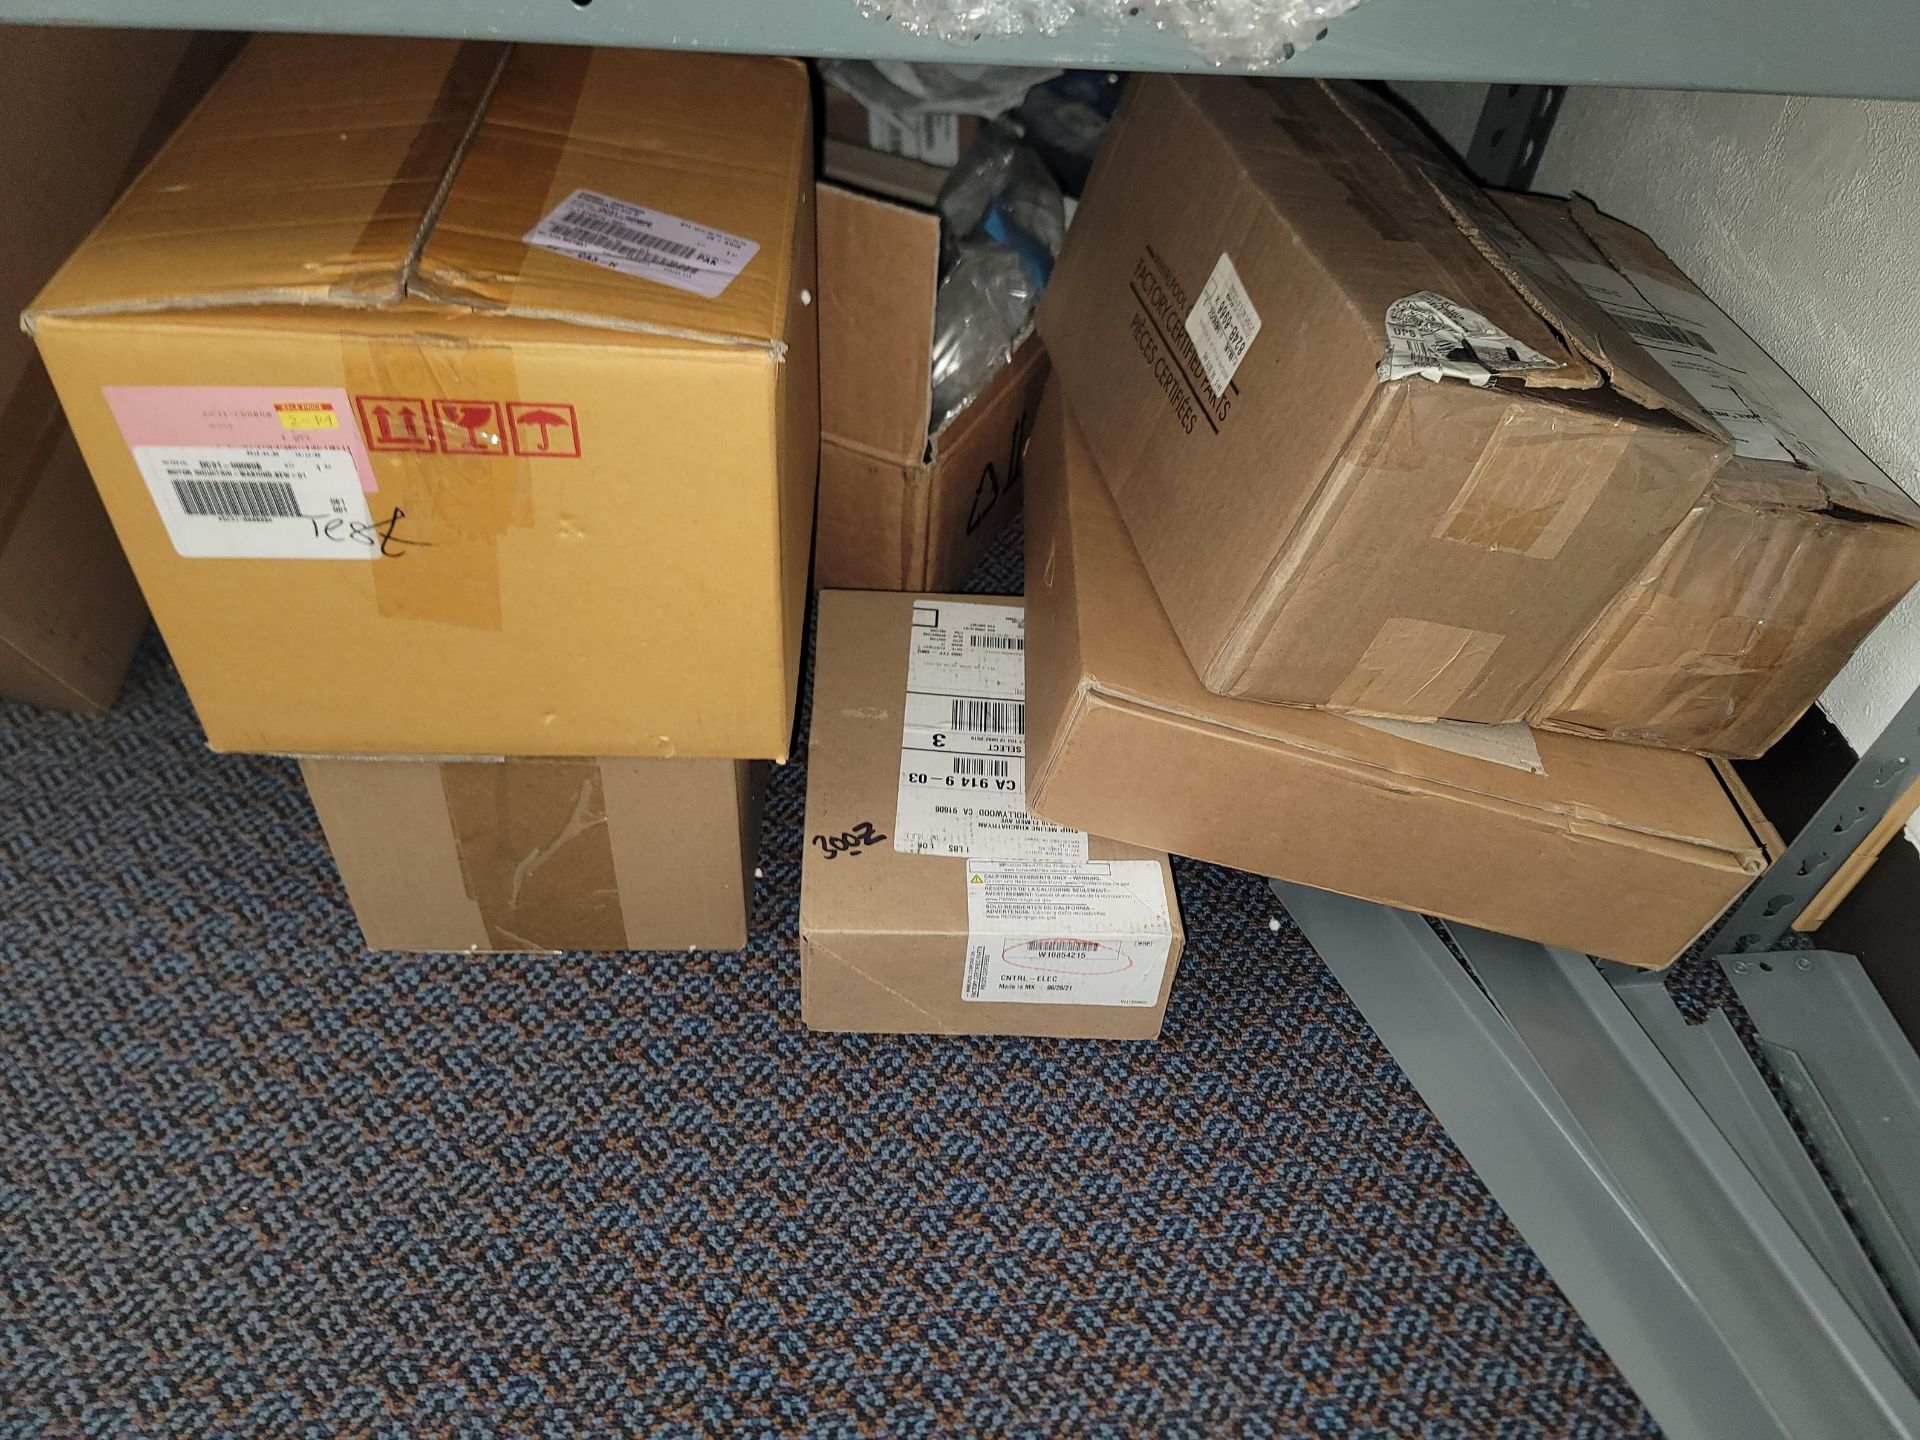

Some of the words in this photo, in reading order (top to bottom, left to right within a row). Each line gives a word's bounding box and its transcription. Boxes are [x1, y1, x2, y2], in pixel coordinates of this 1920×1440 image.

[1394, 328, 1416, 337] UPS
[1134, 258, 1172, 321] FACTORY
[1166, 311, 1204, 378] CERTIFIED
[1200, 377, 1231, 422] PARTS
[1154, 358, 1197, 435] CERTIFIÉES
[302, 507, 432, 557] Test
[932, 733, 946, 747] 3
[988, 744, 1022, 753] SELECT
[961, 777, 989, 789] 914
[996, 780, 1016, 790] CA
[962, 808, 974, 816] CA
[978, 810, 1028, 819] HOLLYWOOD
[1033, 825, 1058, 833] MELINE
[948, 844, 964, 853] LBS
[1038, 951, 1086, 959] W10854215
